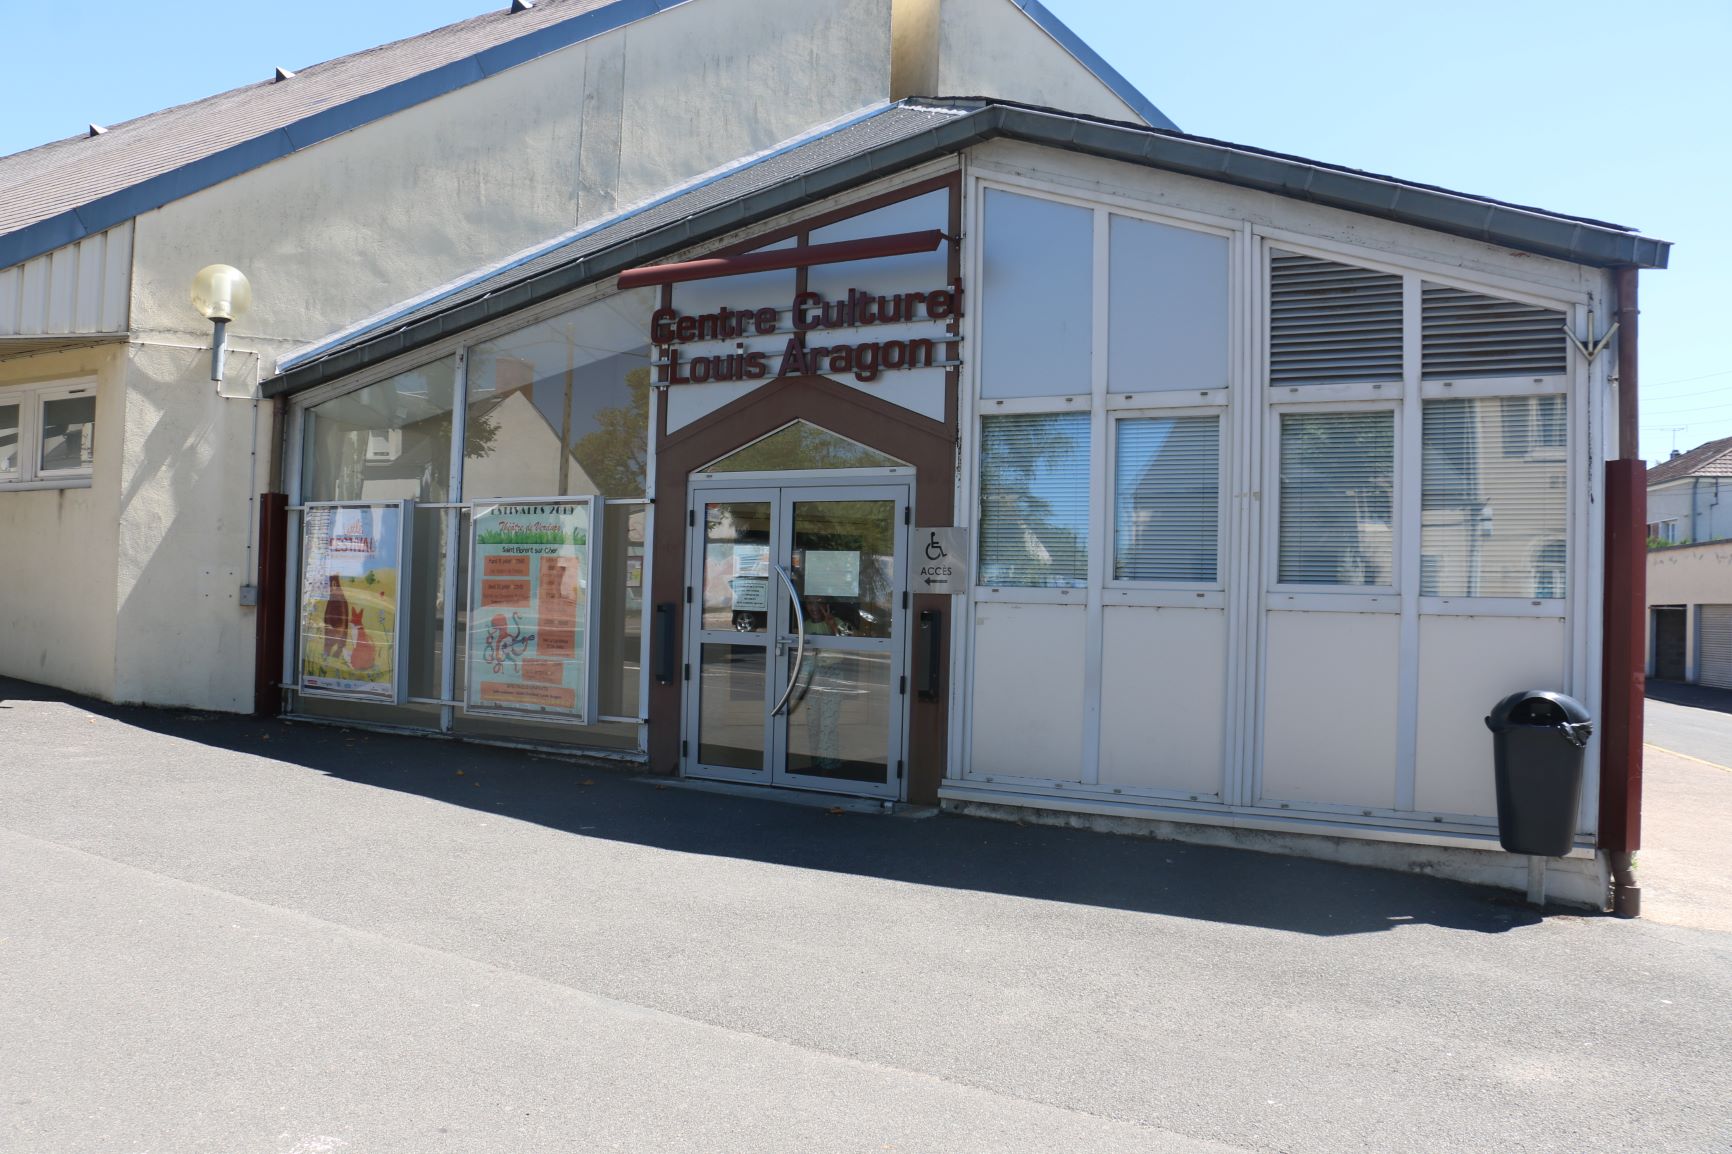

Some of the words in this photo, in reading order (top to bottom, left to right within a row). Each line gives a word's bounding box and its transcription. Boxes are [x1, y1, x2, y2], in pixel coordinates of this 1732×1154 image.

[650, 306, 777, 344] Centre
[792, 277, 963, 331] Culturel
[669, 342, 767, 384] Louis
[777, 337, 933, 382] Aragon
[549, 506, 574, 515] 2019
[920, 564, 953, 576] ACCÈS
